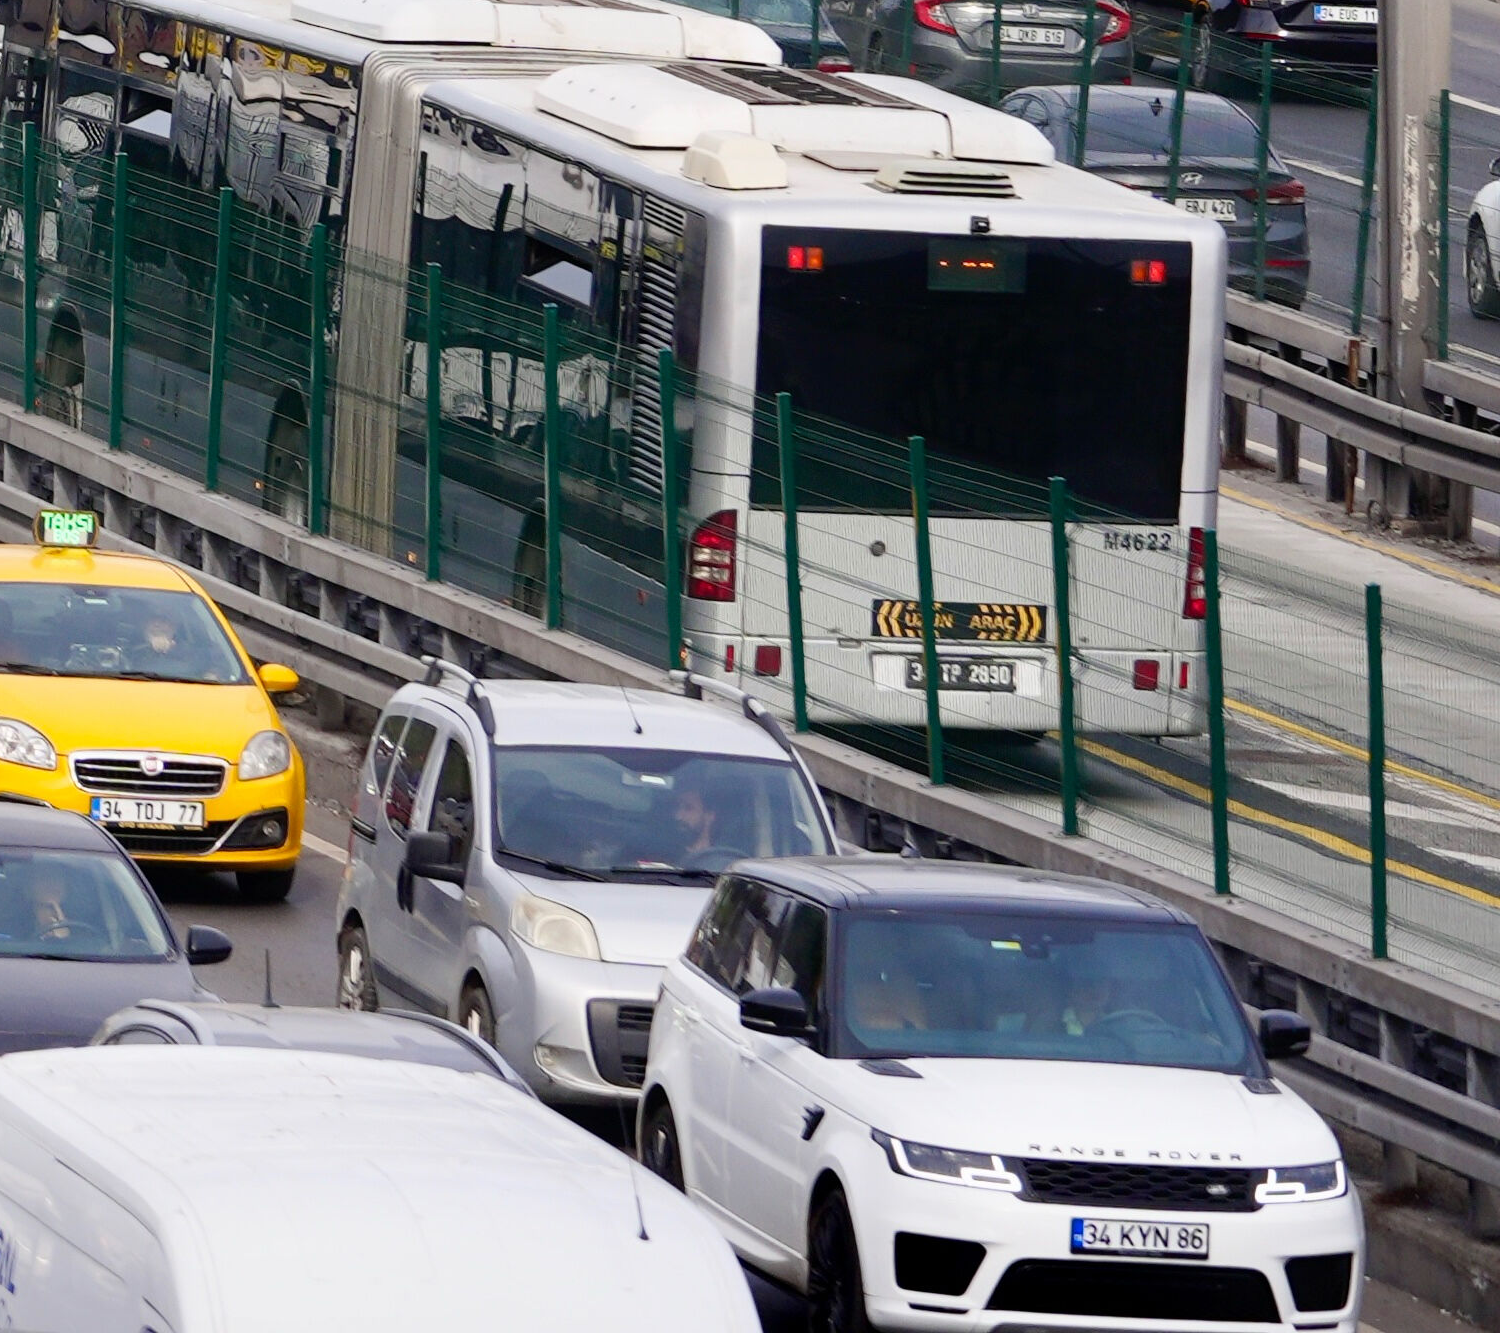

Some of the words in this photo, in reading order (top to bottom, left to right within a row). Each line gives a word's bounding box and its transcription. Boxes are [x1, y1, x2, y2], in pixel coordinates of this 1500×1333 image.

[1321, 5, 1334, 18] 34
[939, 662, 963, 683] TP
[968, 663, 1012, 686] 2890
[102, 801, 123, 819] 34
[179, 804, 198, 823] 77
[1028, 1142, 1126, 1159] RANGE
[1147, 1150, 1243, 1164] ROVER
[1082, 1223, 1112, 1250] 34
[1120, 1224, 1169, 1250] KYN
[1177, 1227, 1205, 1251] 86
